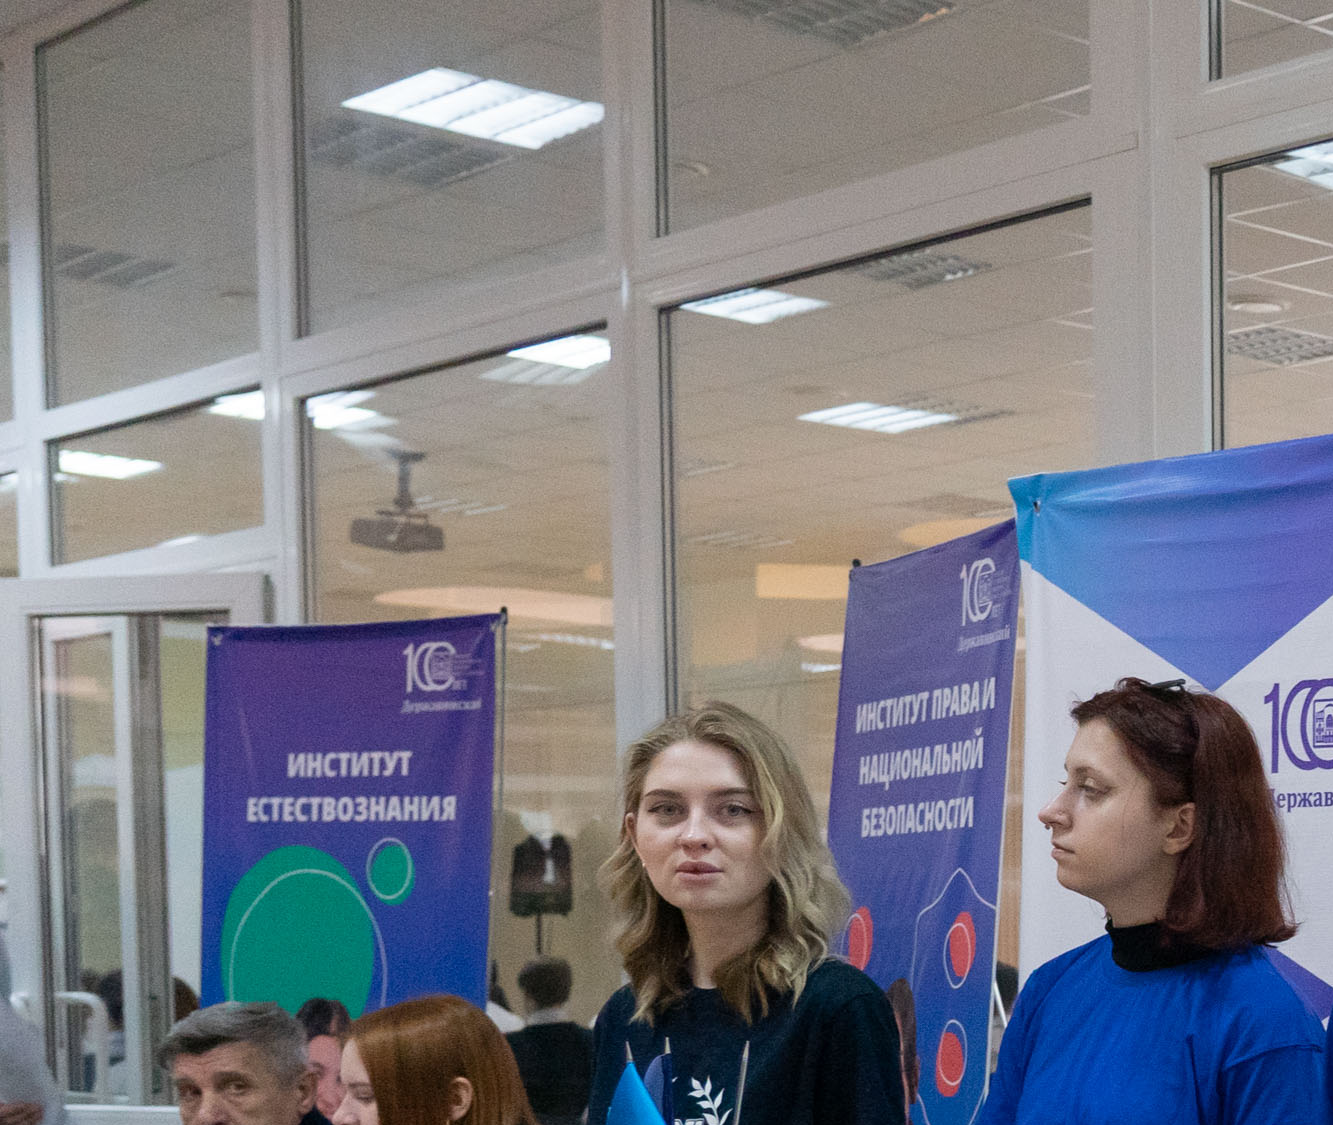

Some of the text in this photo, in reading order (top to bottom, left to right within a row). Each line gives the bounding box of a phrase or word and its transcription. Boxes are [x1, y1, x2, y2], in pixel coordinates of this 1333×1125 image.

[856, 677, 996, 734] ИНСТИТУТ ПРАВА И
[287, 751, 413, 778] ИНСТИТУТ
[859, 727, 984, 790] НАЦИОНАЛЬНОЙ
[246, 796, 457, 822] ЕСТЕСТВОЗНАНИЯ
[861, 796, 974, 838] БЕЗОПАСНОСТИ
